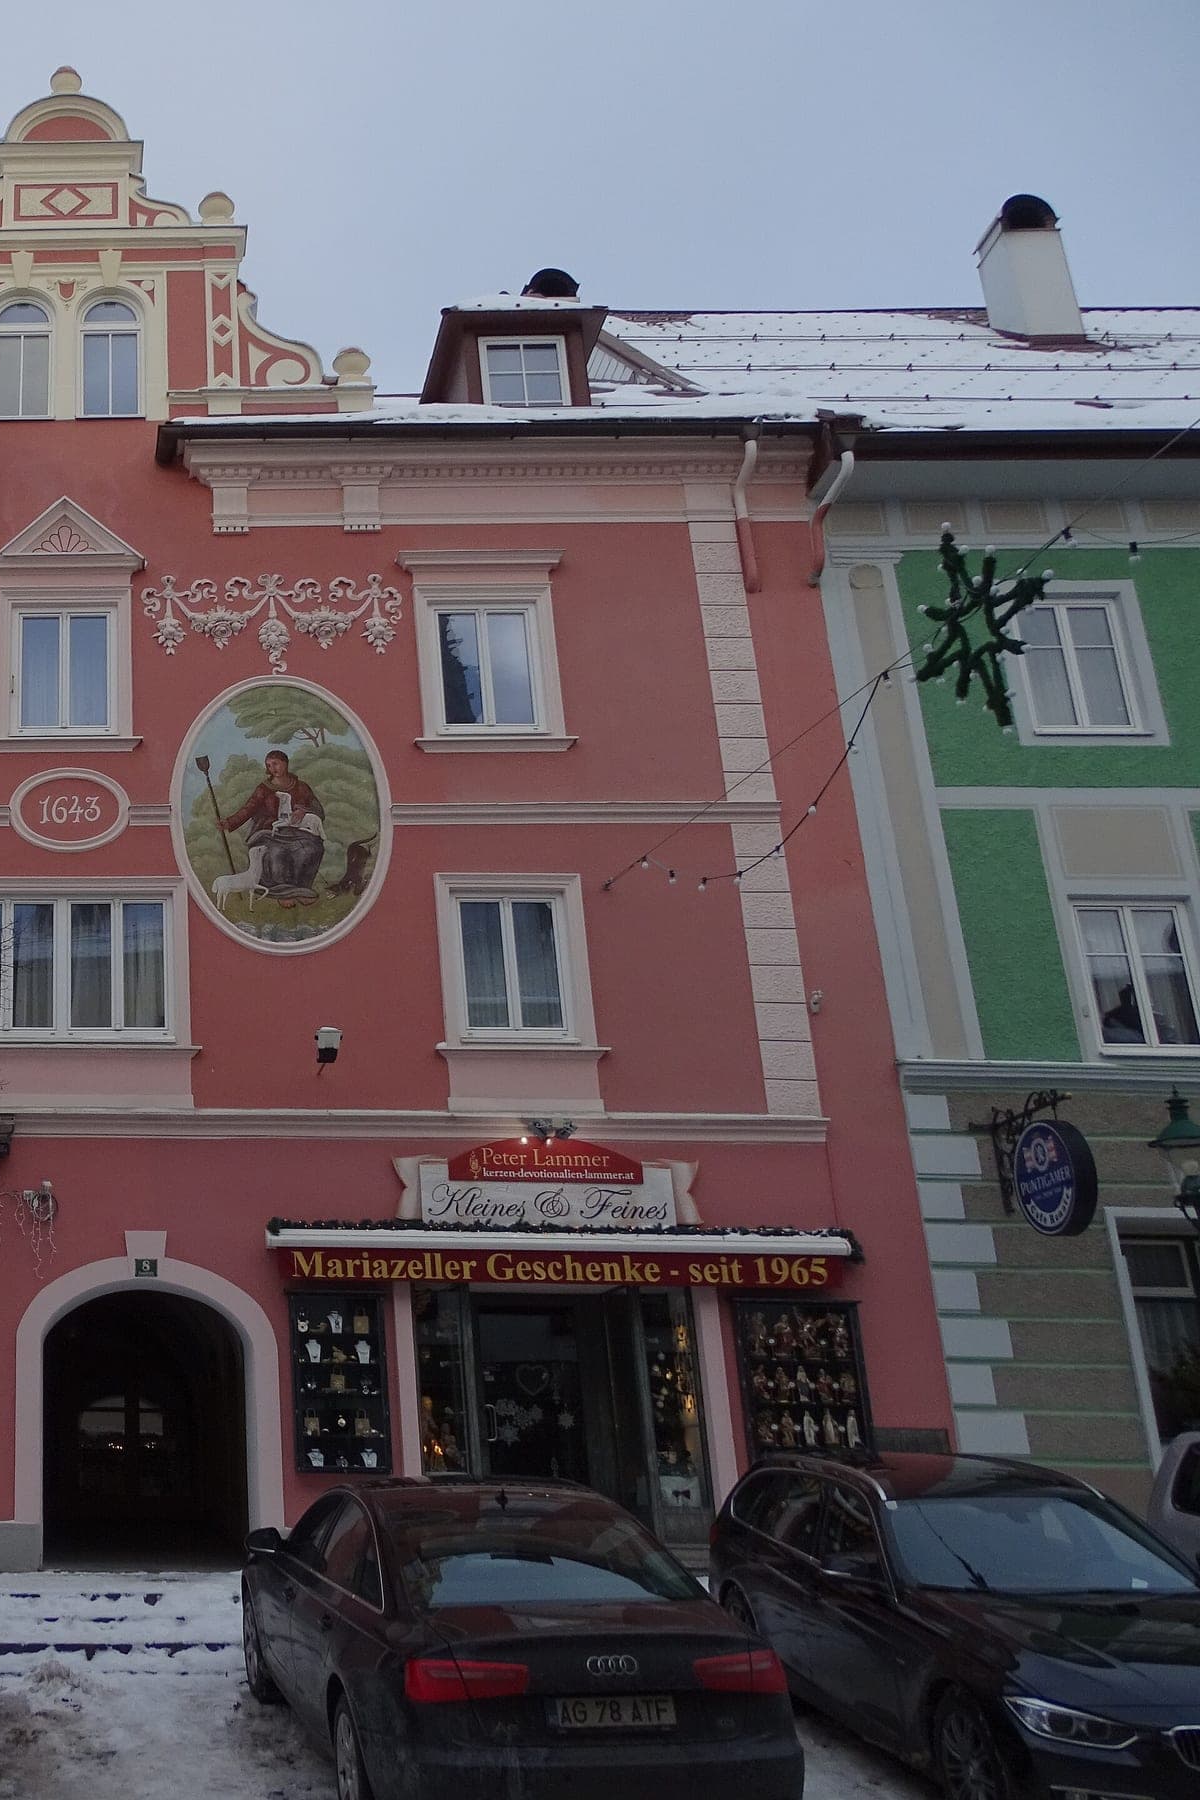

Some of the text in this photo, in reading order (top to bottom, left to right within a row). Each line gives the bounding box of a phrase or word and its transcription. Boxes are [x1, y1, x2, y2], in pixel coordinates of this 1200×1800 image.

[39, 795, 101, 824] 1643
[482, 1148, 610, 1167] Peter Lammer
[483, 1167, 635, 1180] kerzen-devotionalien-lammer.at
[1020, 1166, 1072, 1195] PUNTIGAMER
[428, 1183, 669, 1220] Kleines & Feines
[142, 1260, 151, 1271] 8
[291, 1250, 477, 1280] Mariazeller
[487, 1252, 661, 1283] Geschenke
[688, 1256, 743, 1284] seit
[753, 1257, 829, 1285] 1965
[560, 1701, 588, 1724] AG
[595, 1700, 622, 1723] 78
